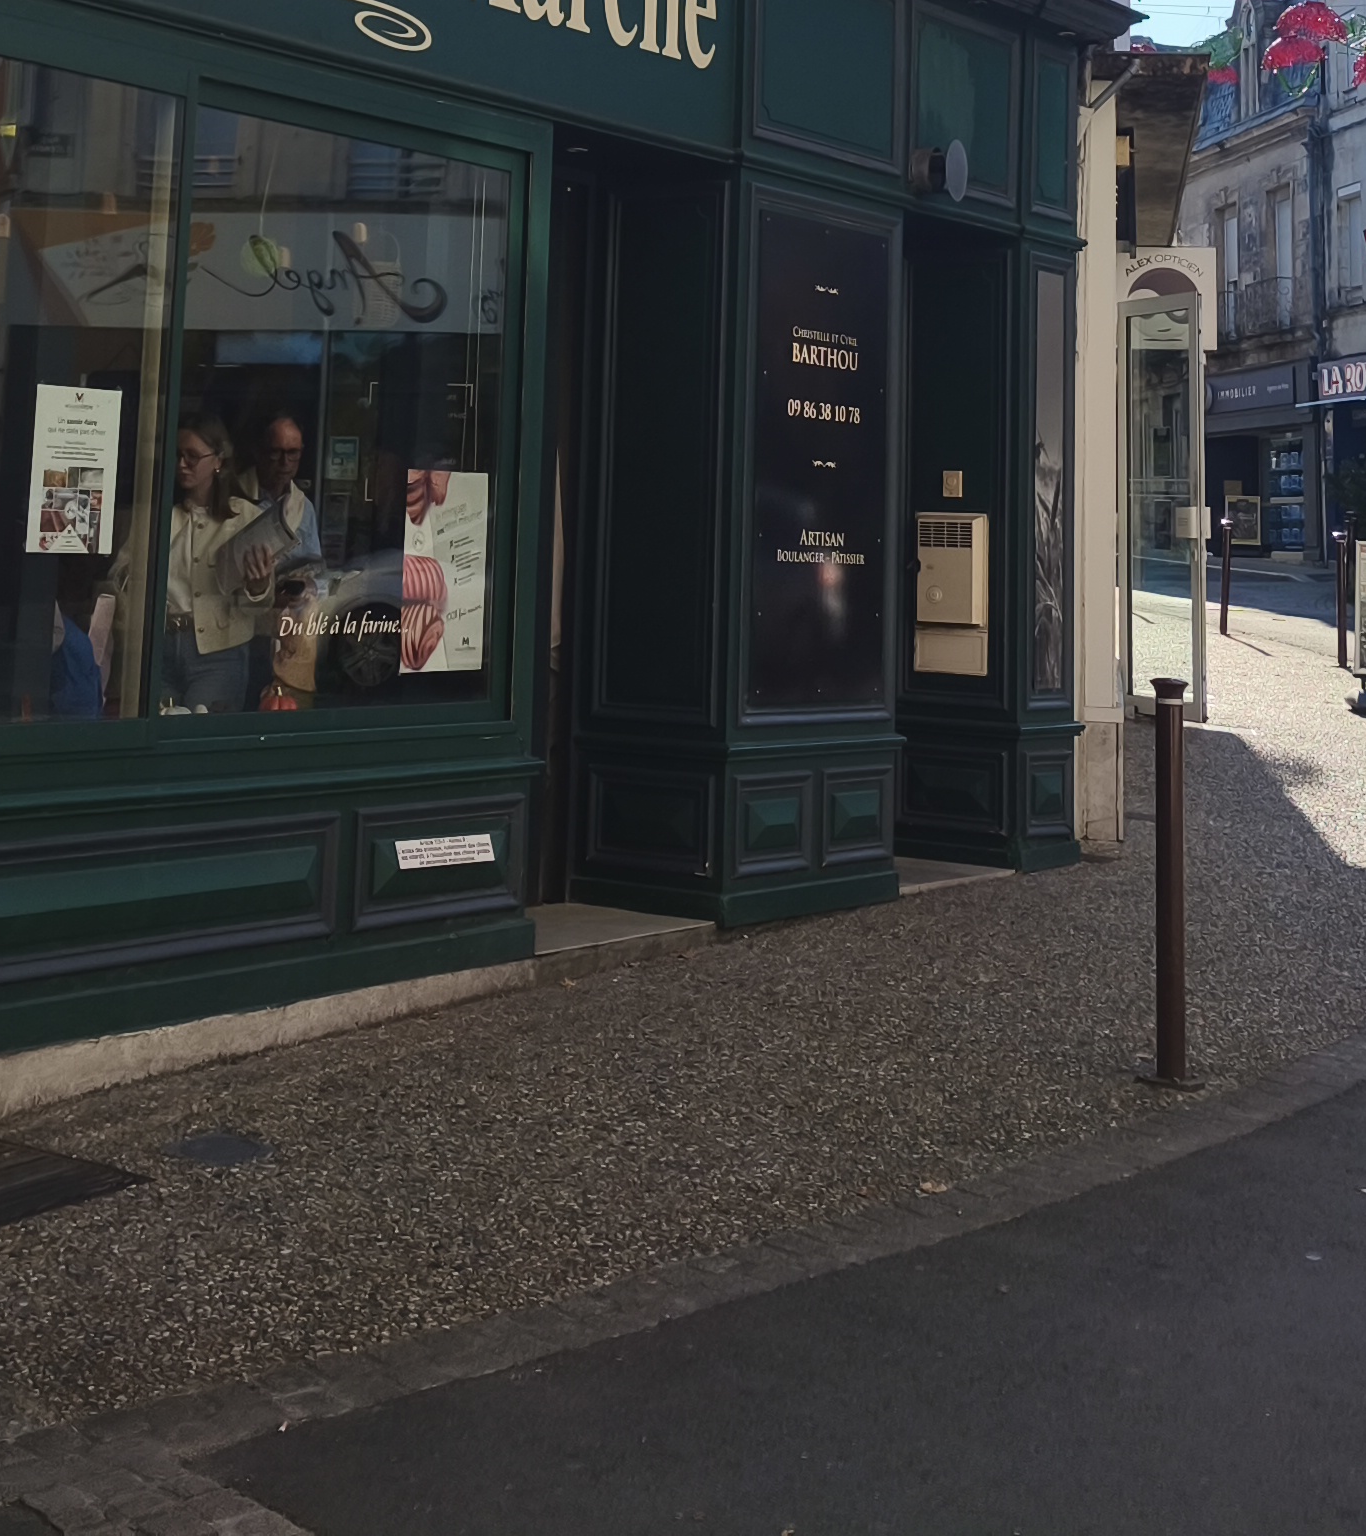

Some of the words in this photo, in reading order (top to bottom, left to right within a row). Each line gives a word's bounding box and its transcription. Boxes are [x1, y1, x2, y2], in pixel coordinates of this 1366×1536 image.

[1125, 255, 1153, 278] ALEX
[1154, 254, 1204, 278] OPTICIEN
[792, 342, 859, 371] BARTHOU
[1217, 385, 1257, 400] IMMOBILIER
[1321, 365, 1343, 396] LA
[787, 398, 801, 417] 09
[803, 400, 817, 419] 86
[818, 402, 832, 421] 38
[835, 405, 846, 423] 10
[848, 406, 861, 424] 78
[799, 528, 845, 547] ARTISAN
[776, 549, 825, 563] BOULANGER
[831, 550, 865, 565] PÂTISSIER
[279, 616, 302, 637] Du
[306, 611, 329, 637] blé
[329, 614, 339, 636] à
[343, 611, 356, 635] la
